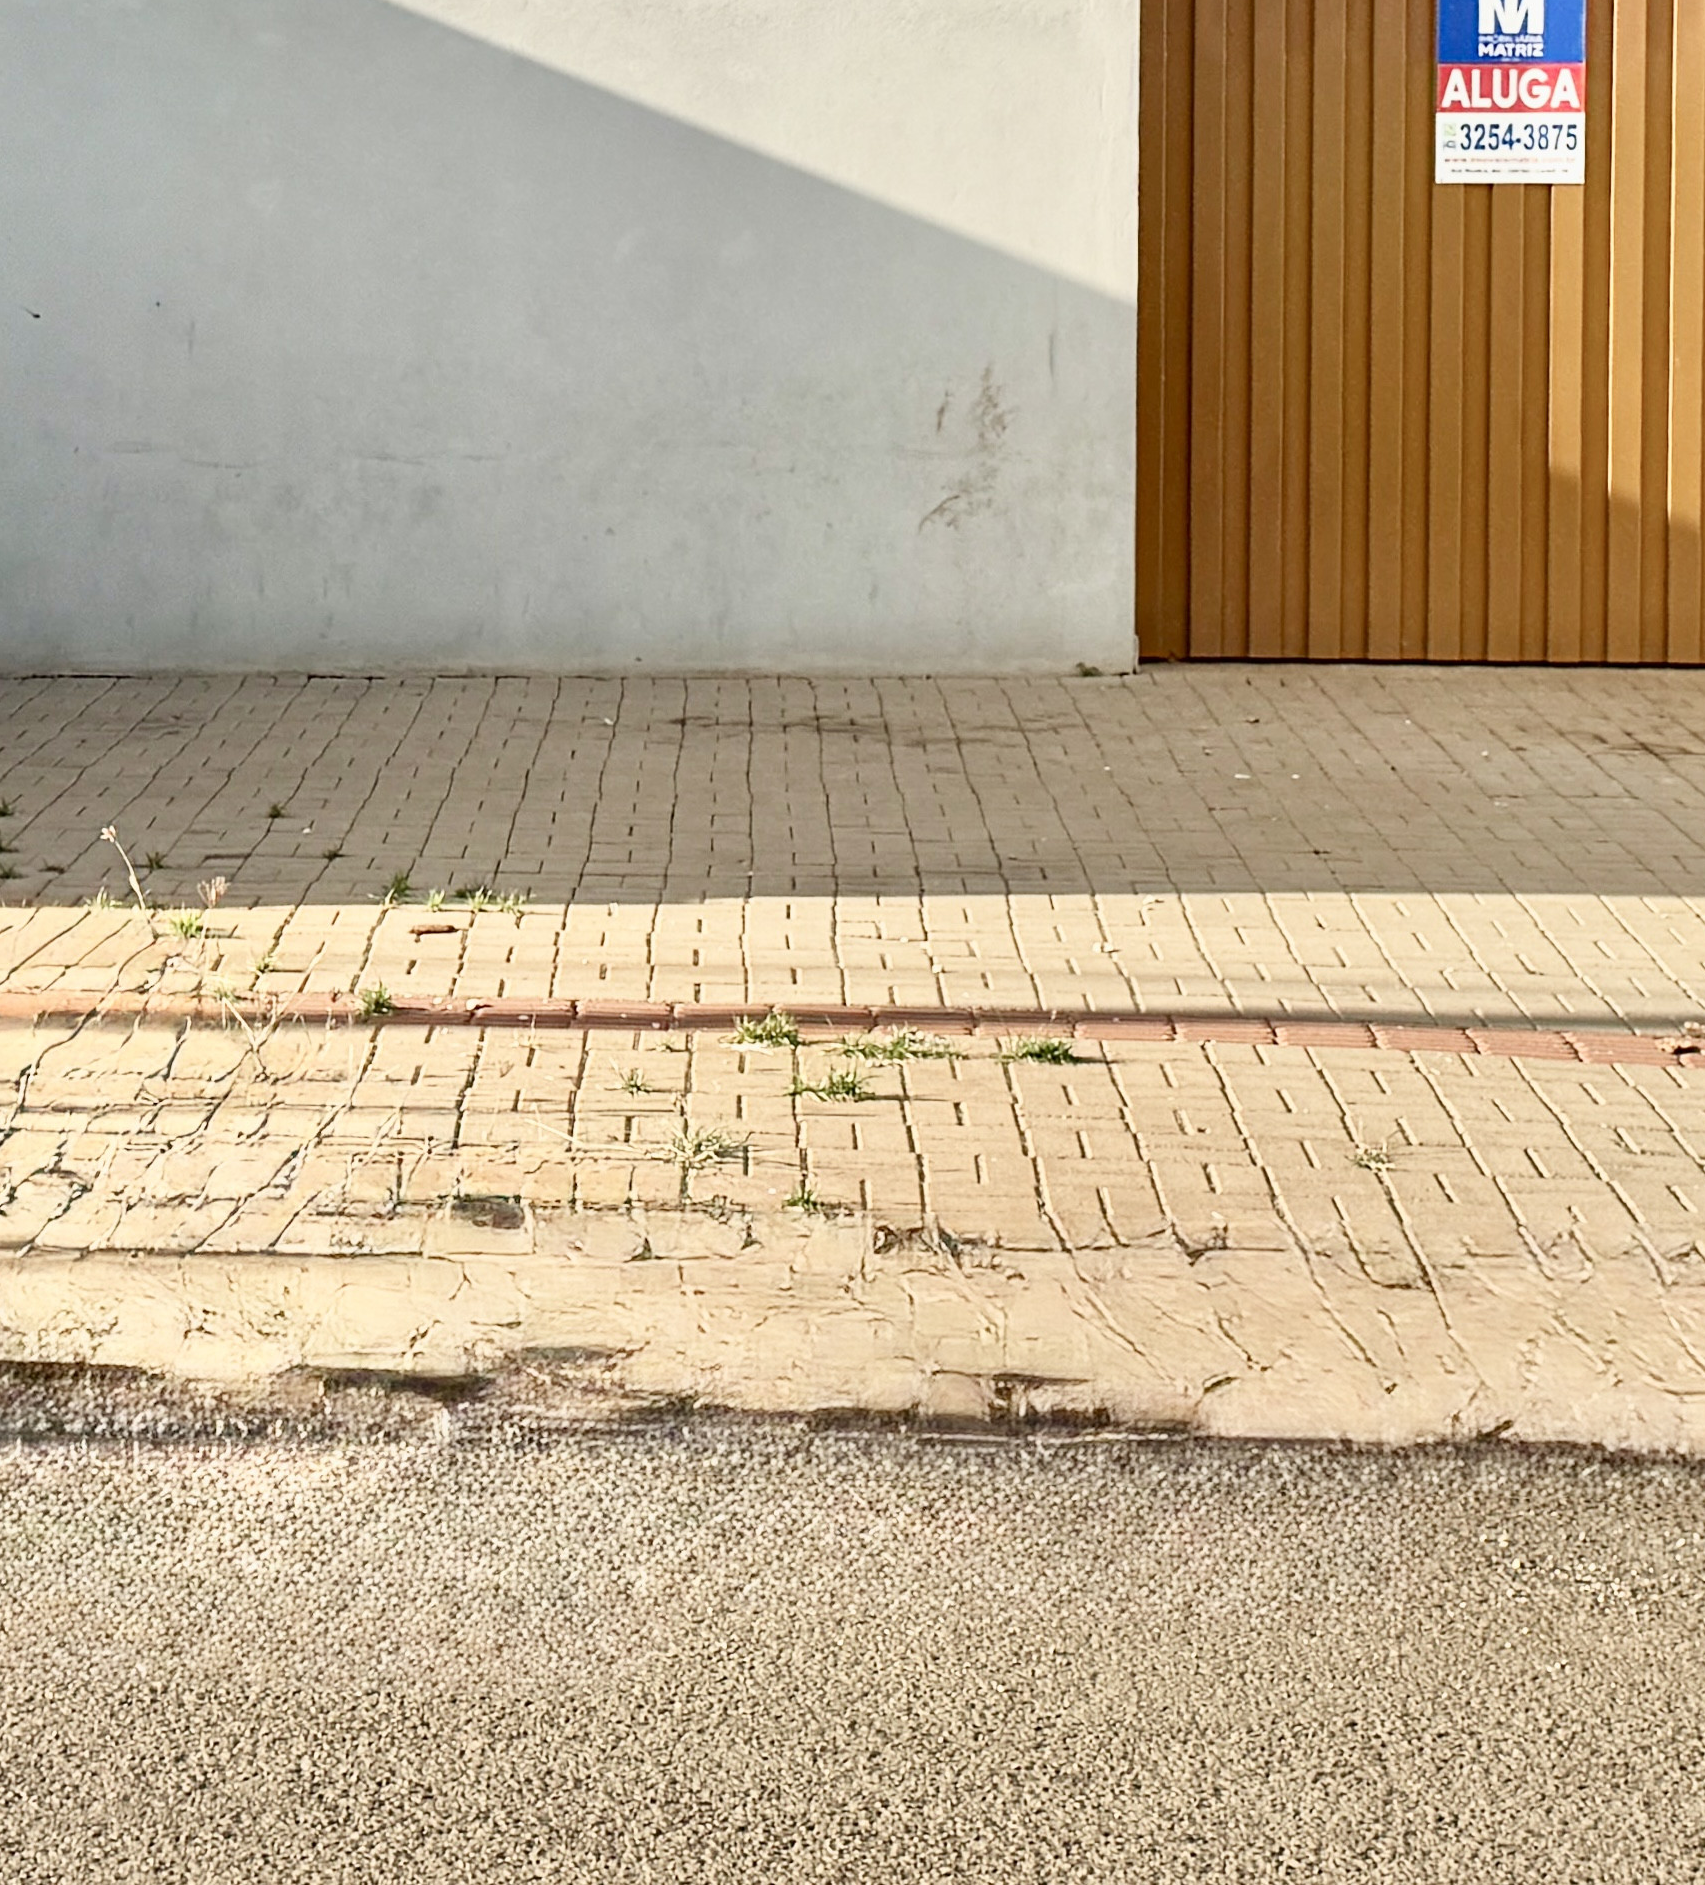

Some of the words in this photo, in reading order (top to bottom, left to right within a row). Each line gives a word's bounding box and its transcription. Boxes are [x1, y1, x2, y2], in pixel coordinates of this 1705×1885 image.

[1478, 43, 1544, 57] MATRIZ
[1441, 68, 1581, 109] ALUGA
[1460, 123, 1578, 151] 3254-3875
